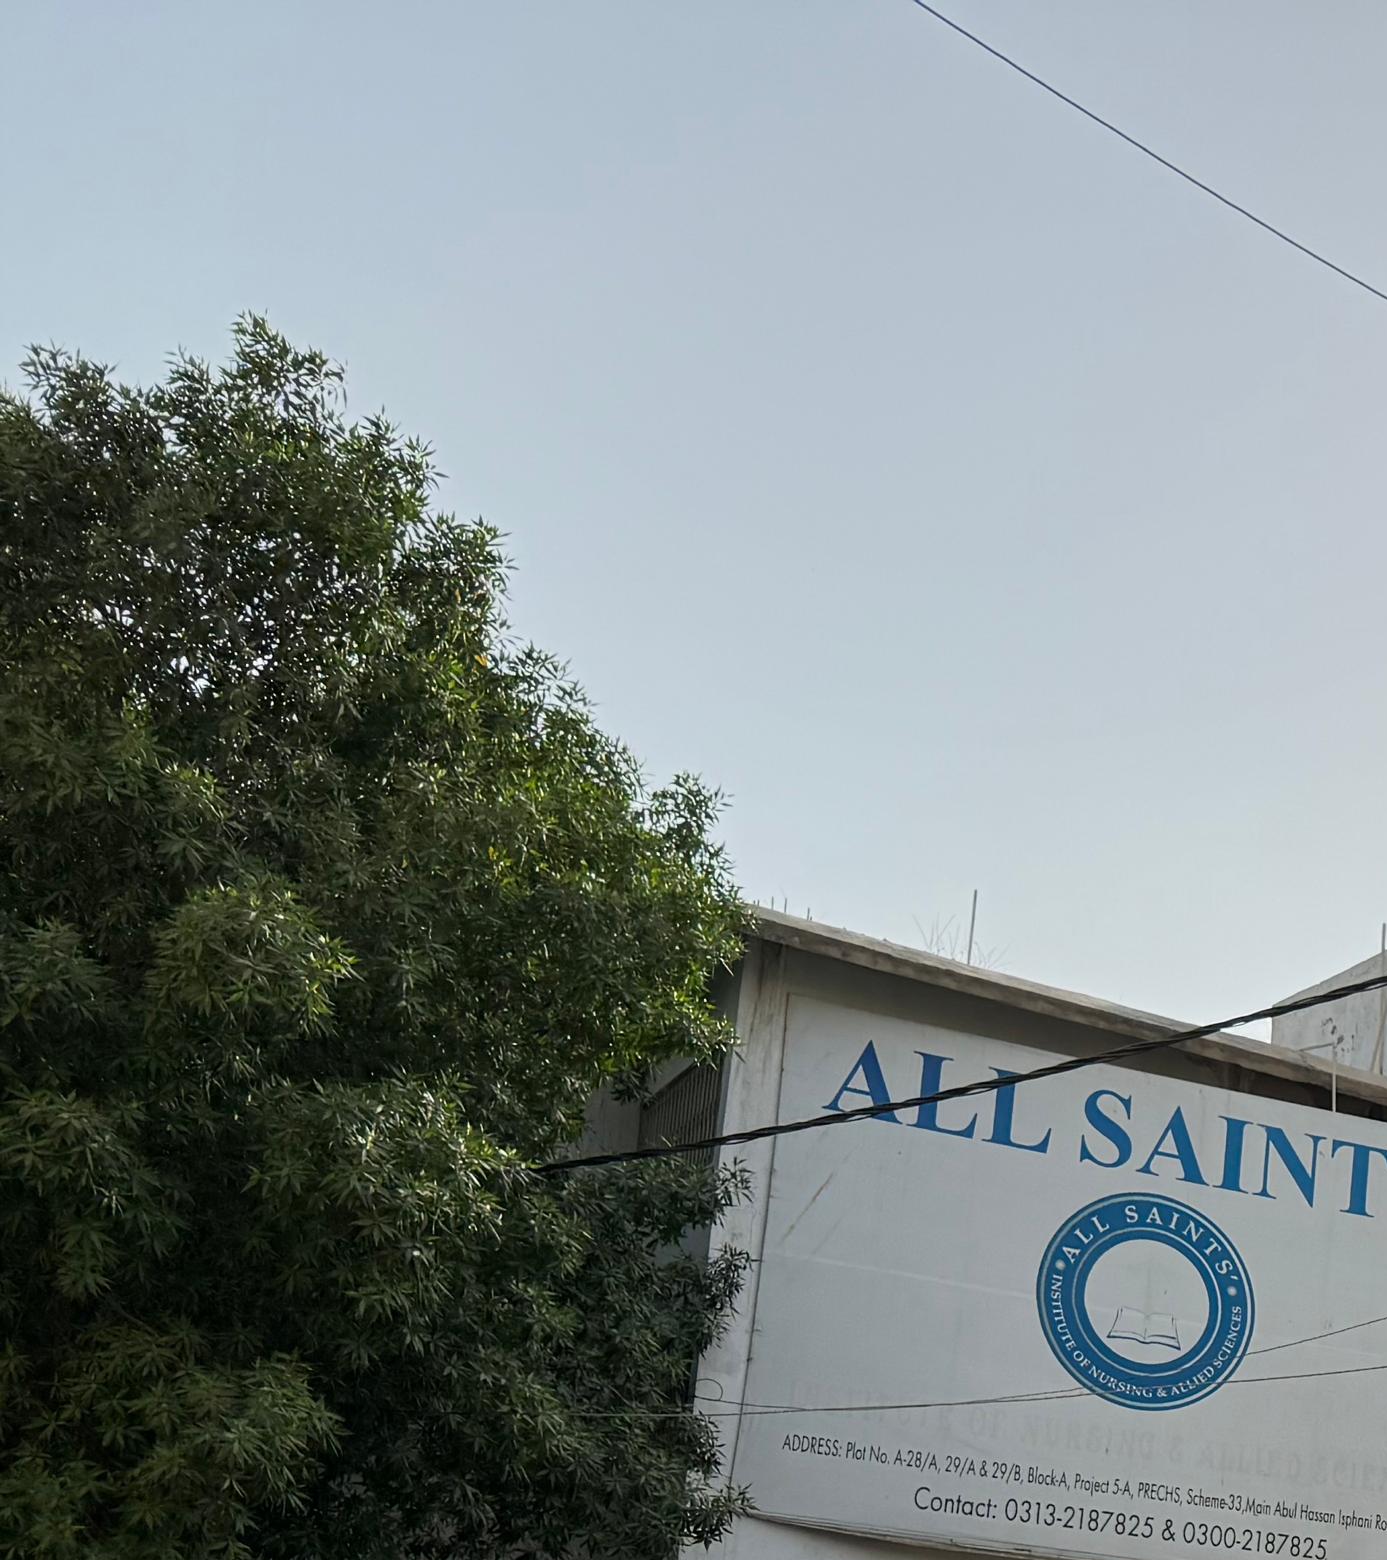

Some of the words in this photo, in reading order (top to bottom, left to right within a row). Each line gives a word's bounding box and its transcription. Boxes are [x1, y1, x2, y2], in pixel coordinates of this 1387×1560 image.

[822, 1039, 1053, 1154] ALL
[1062, 1215, 1110, 1264] ALL
[1124, 1205, 1239, 1282] SAINTS'
[1051, 1274, 1077, 1351] INSTITUTE
[1073, 1351, 1091, 1370] OF
[1088, 1365, 1154, 1398] NURSING
[1156, 1387, 1168, 1398] &
[1170, 1366, 1215, 1396] ALLIED
[1213, 1305, 1242, 1369] SCIENCES
[782, 1433, 843, 1458] ADDRESS:
[846, 1442, 867, 1461] Plot
[869, 1446, 890, 1465] No.
[894, 1449, 942, 1475] A-28/A,
[945, 1456, 977, 1478] 29/A
[979, 1461, 988, 1477] &
[992, 1461, 1025, 1484] 29/B,
[1027, 1467, 1071, 1491] Block-A,
[1074, 1474, 1110, 1497] Project
[1112, 1478, 1135, 1500] 5-A,
[1137, 1482, 1183, 1506] PRECHS,
[1273, 1503, 1298, 1520] Abul
[1300, 1505, 1336, 1525] Hassan
[1338, 1510, 1373, 1531] Isphani
[913, 1487, 998, 1519] Contact:
[1005, 1498, 1154, 1538] 0313-2187825
[1162, 1520, 1176, 1541] &
